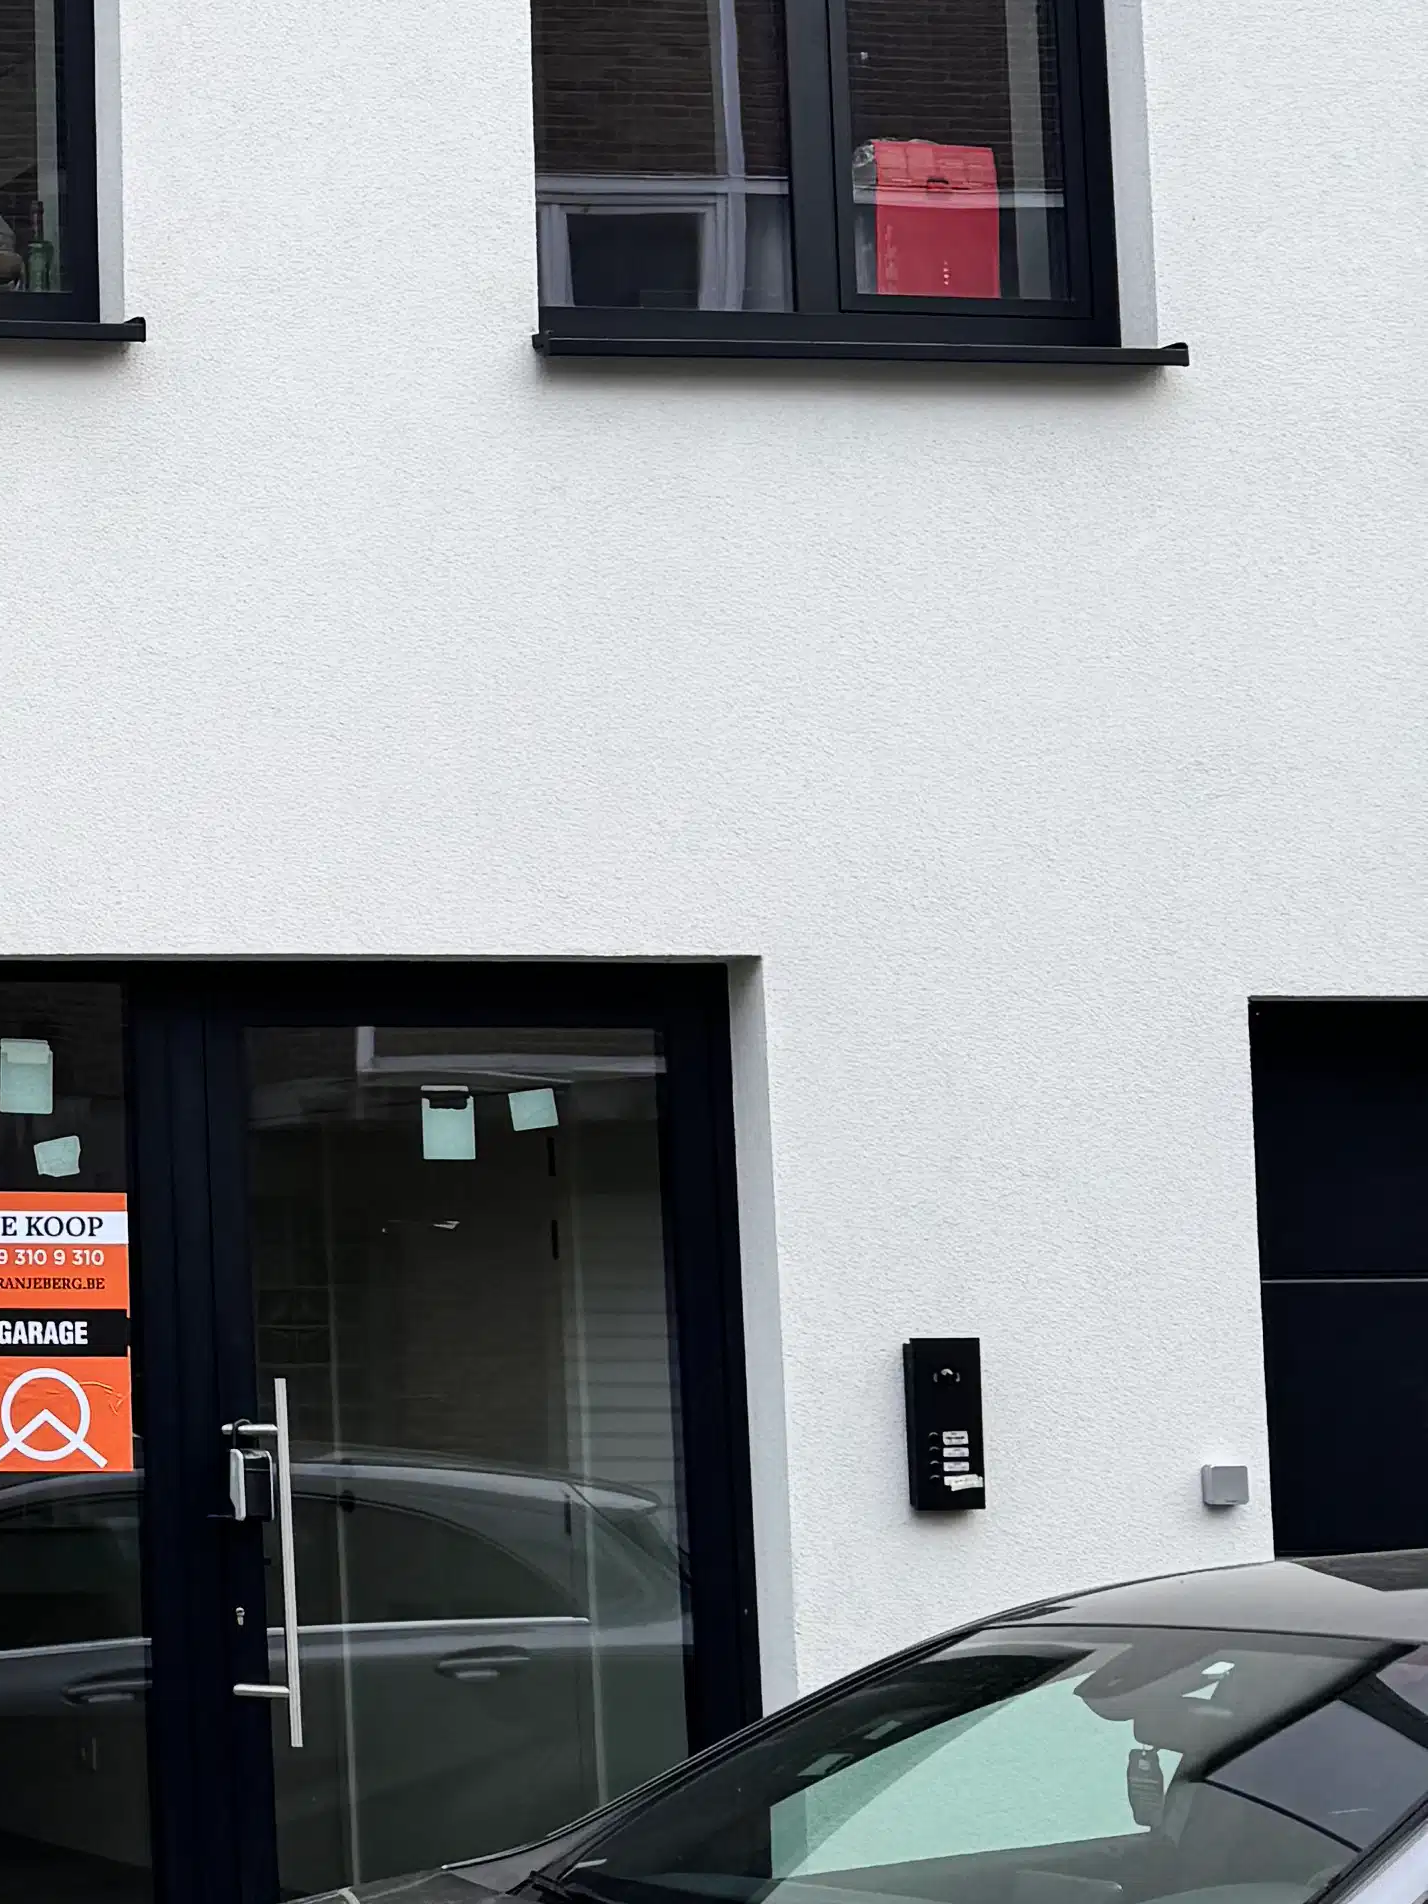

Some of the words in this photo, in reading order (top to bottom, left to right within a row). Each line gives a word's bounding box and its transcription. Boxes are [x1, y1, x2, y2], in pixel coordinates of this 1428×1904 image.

[25, 1216, 103, 1237] KOOP
[13, 1248, 47, 1265] 310
[52, 1249, 66, 1265] 9
[71, 1249, 104, 1265] 310
